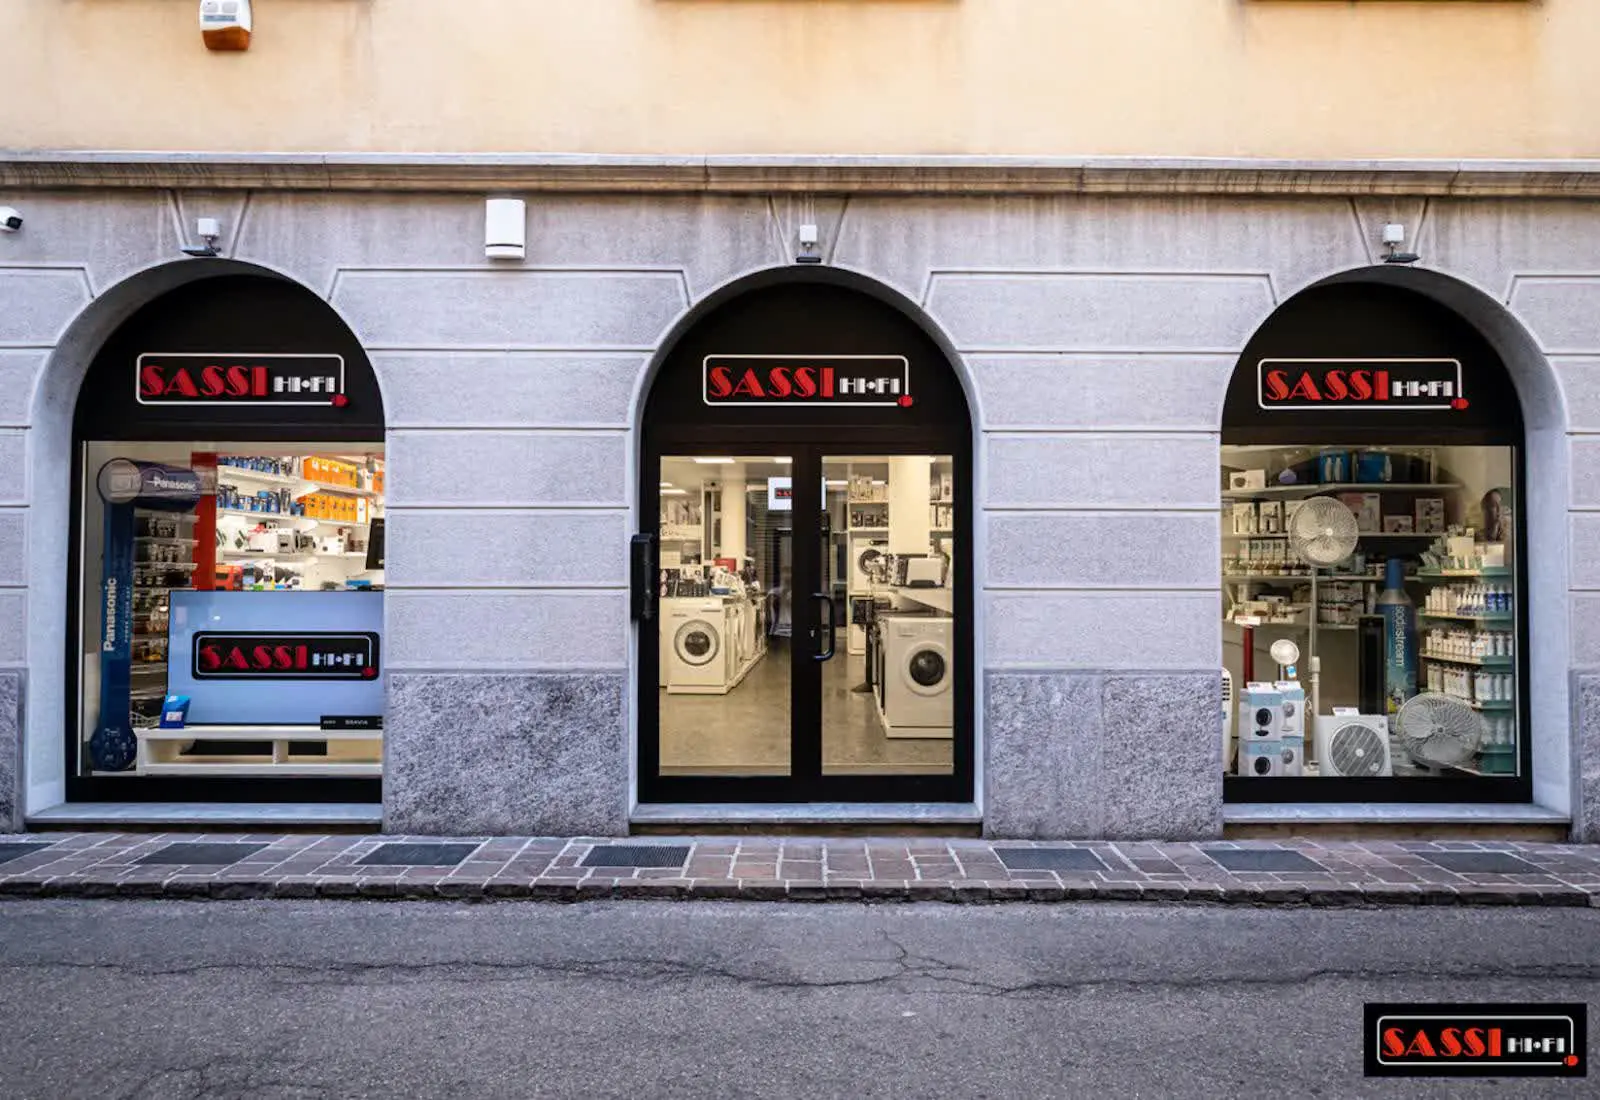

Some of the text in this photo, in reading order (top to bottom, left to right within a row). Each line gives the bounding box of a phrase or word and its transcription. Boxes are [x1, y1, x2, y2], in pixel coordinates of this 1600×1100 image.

[141, 365, 268, 396] SASSI
[709, 367, 834, 397] SASSI
[1266, 370, 1388, 400] SASSI
[103, 577, 117, 651] Panasonic
[1395, 605, 1407, 669] sodastream
[200, 645, 308, 670] SASSI
